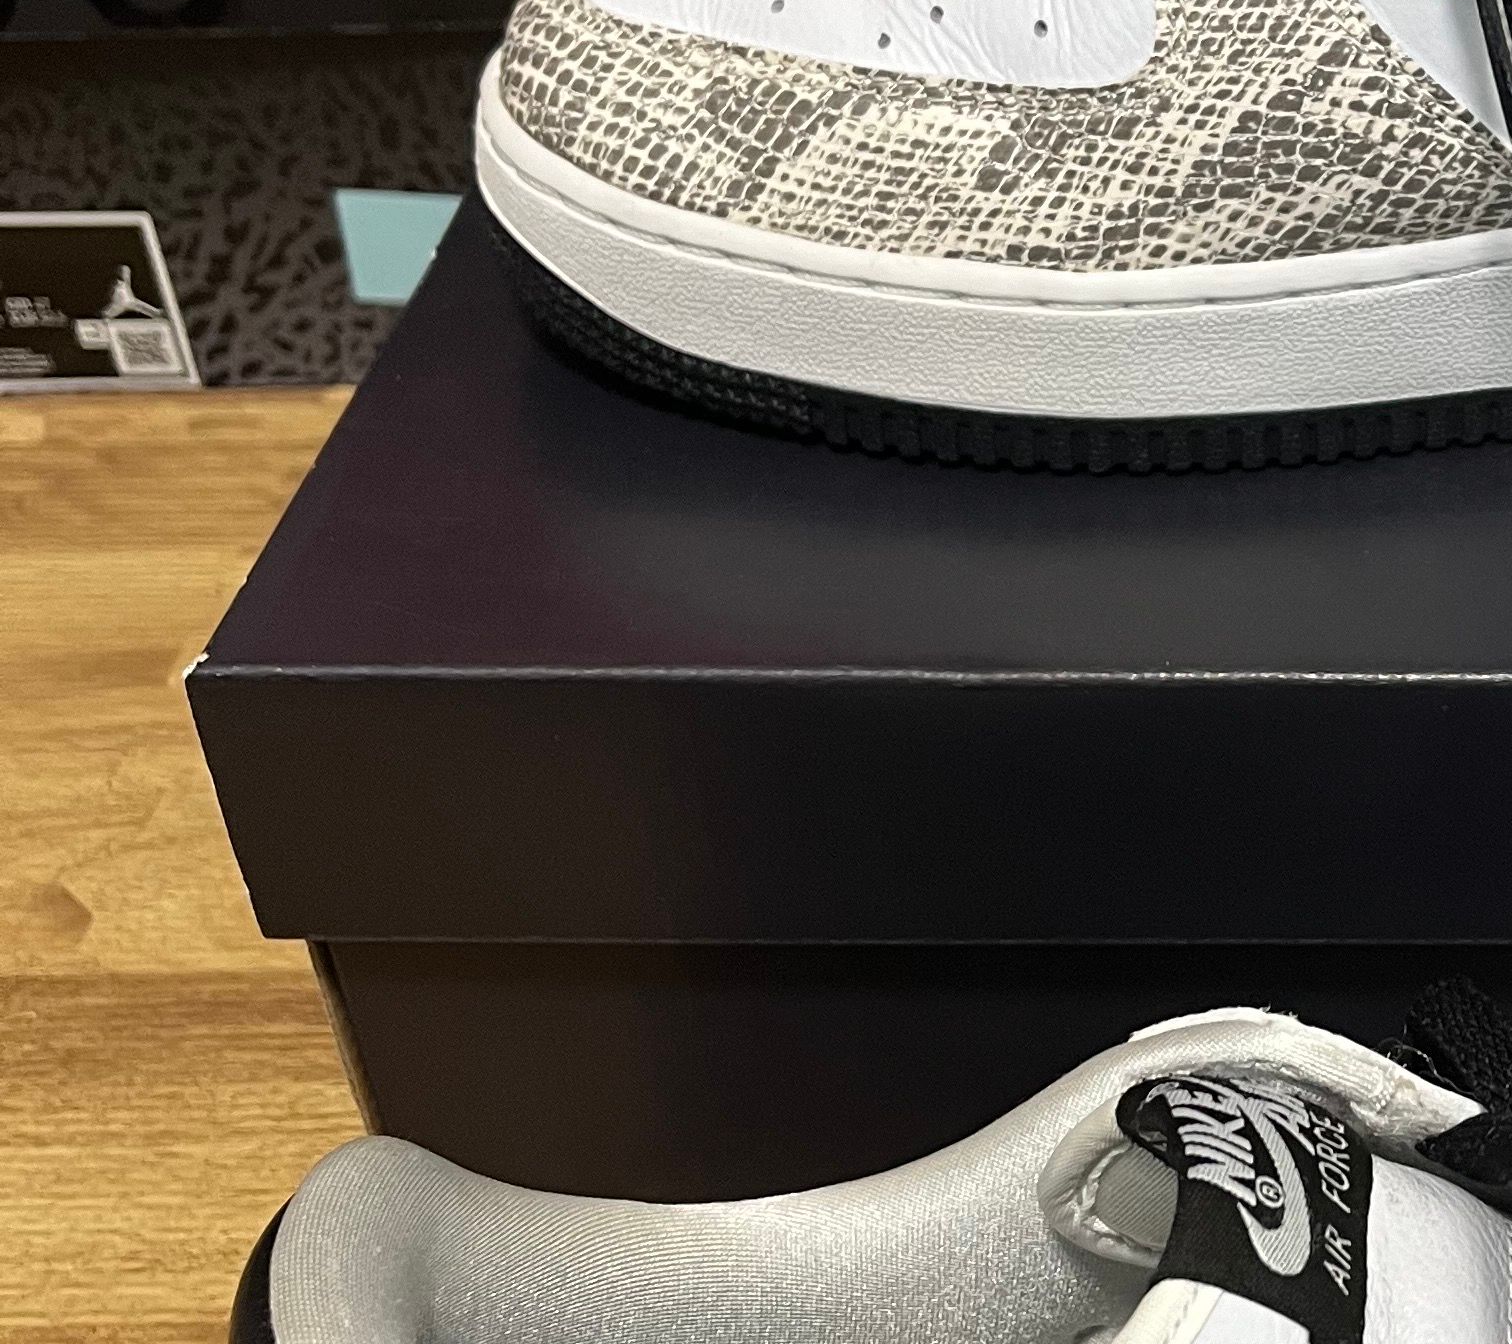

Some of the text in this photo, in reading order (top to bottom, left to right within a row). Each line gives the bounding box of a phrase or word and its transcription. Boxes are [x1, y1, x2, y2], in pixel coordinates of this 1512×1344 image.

[1167, 1088, 1257, 1207] NIKE
[1309, 1109, 1351, 1296] AIR FORCE
